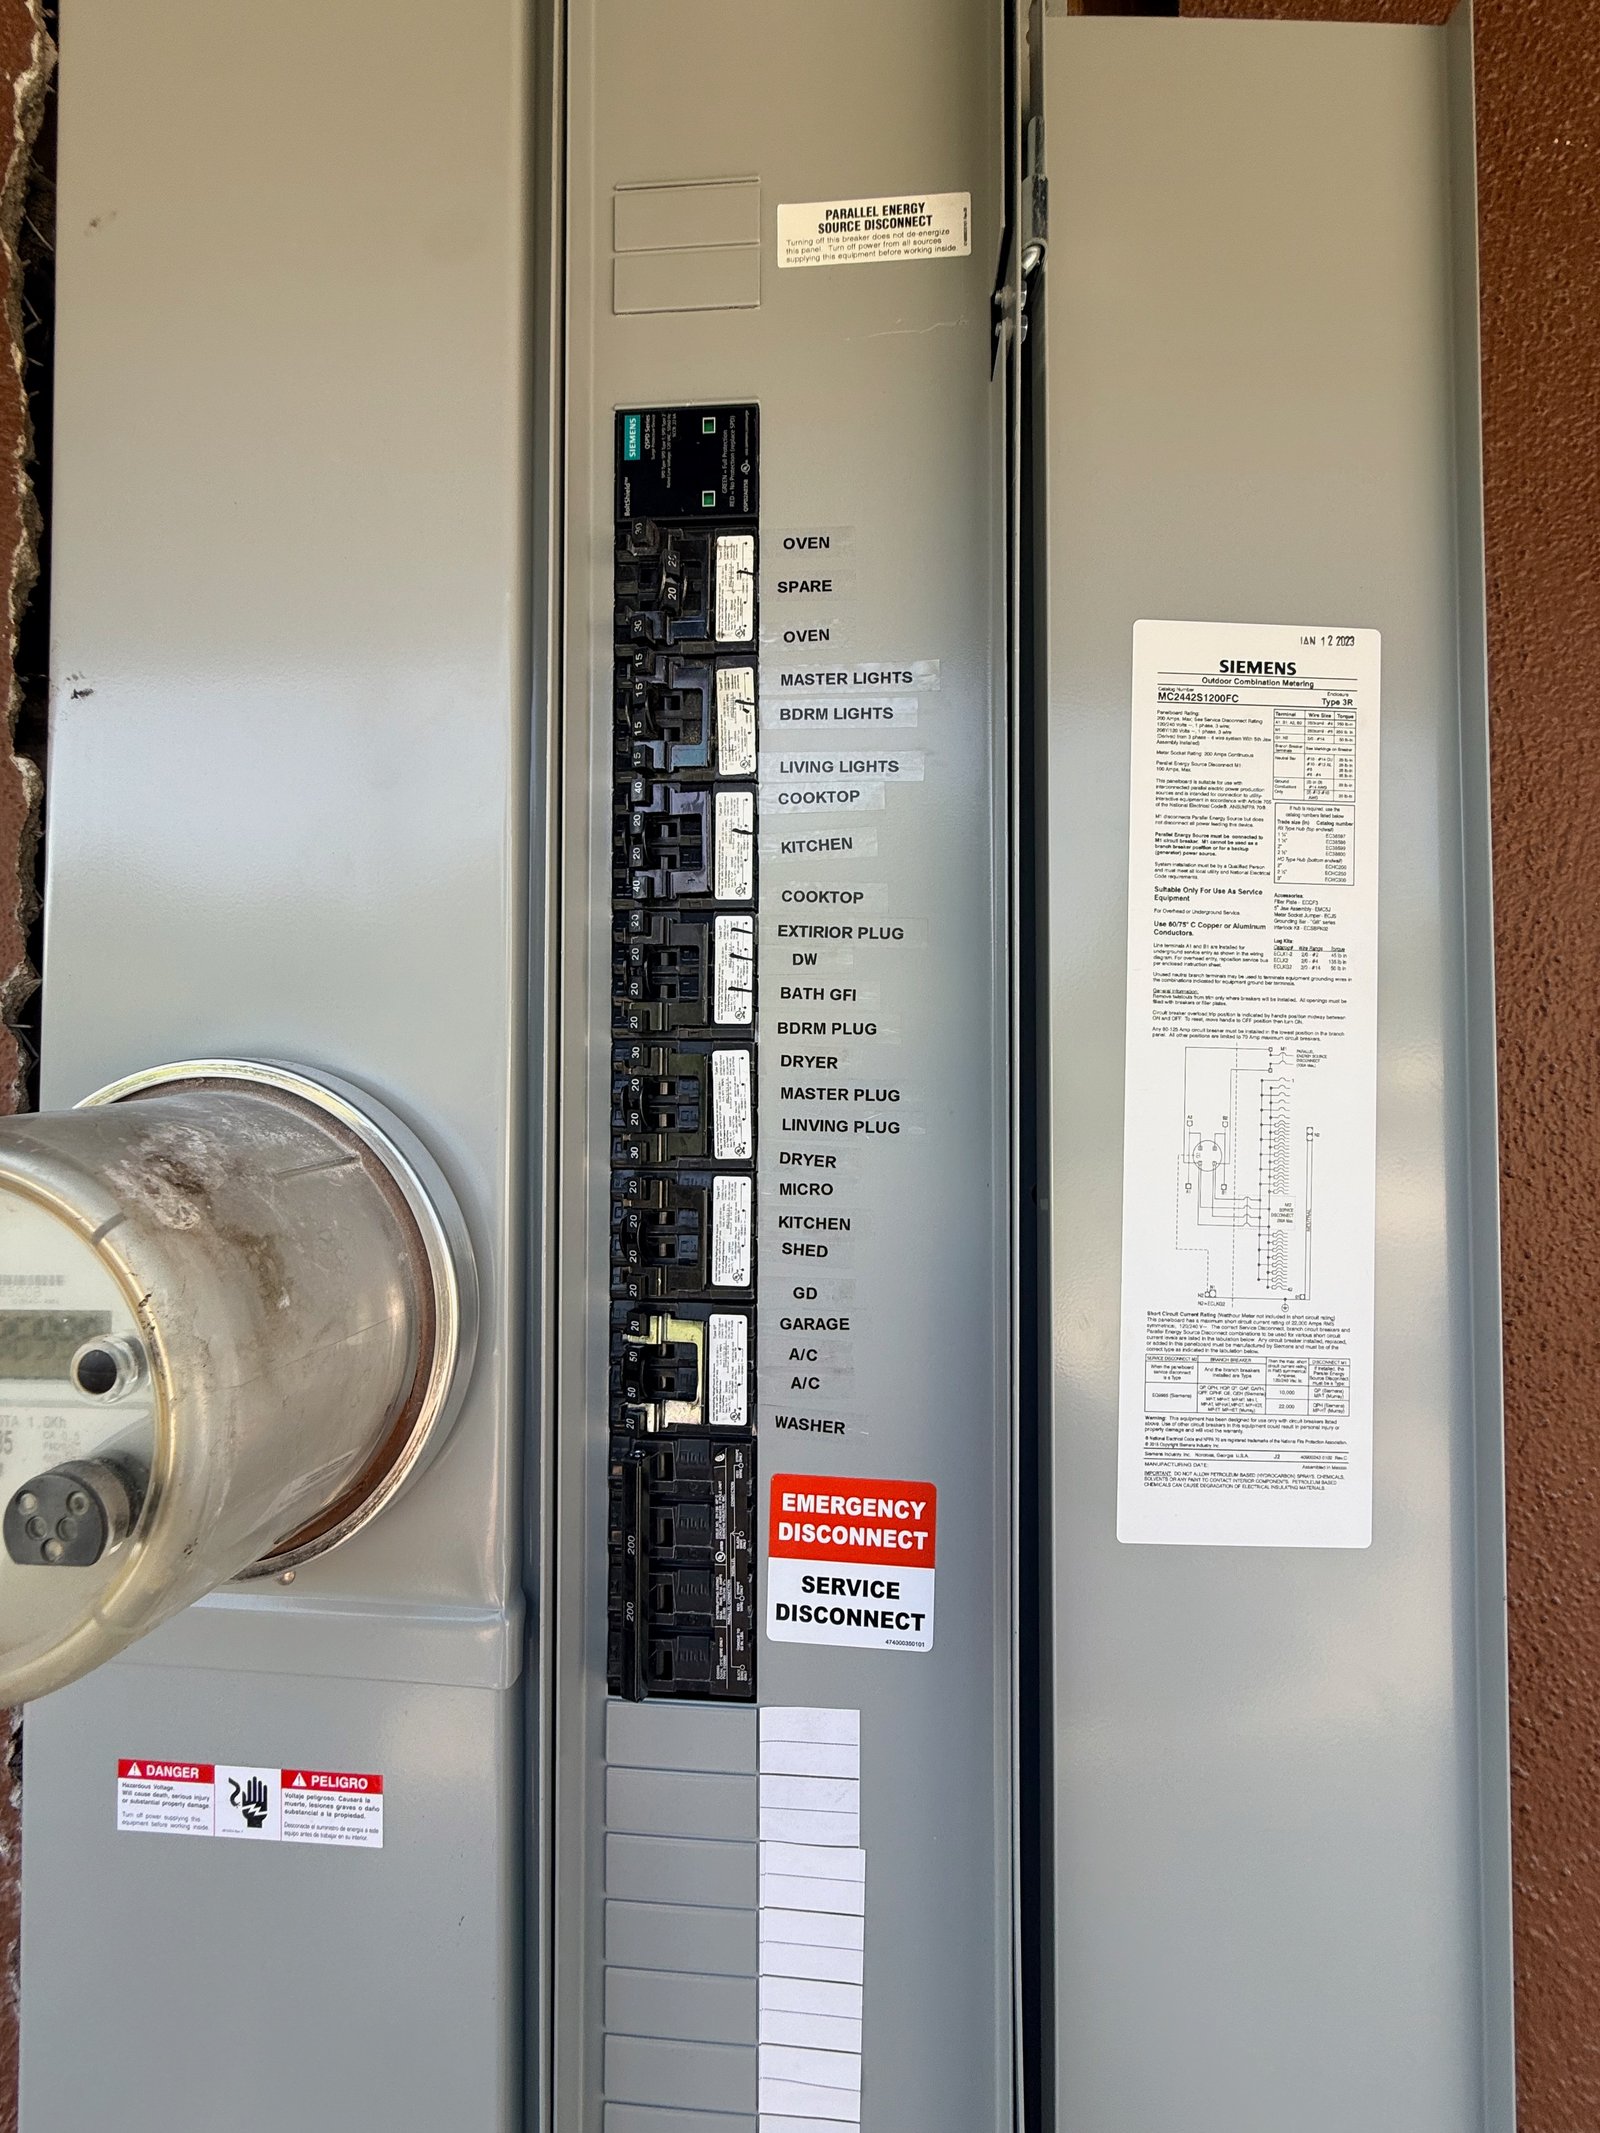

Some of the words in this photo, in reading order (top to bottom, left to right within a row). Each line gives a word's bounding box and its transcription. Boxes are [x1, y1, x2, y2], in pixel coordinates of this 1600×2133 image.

[826, 206, 879, 220] PARALLEL
[882, 202, 925, 216] ENERGY
[818, 220, 861, 234] SOURCE
[865, 215, 933, 231] DISCONNECT
[842, 234, 870, 242] breaker
[907, 229, 950, 238] de-energize
[786, 247, 799, 255] this
[829, 244, 844, 252] Turn
[848, 243, 856, 251] off
[858, 242, 881, 251] power
[787, 254, 820, 264] supplying
[838, 251, 876, 261] equipment
[904, 246, 933, 255] working
[634, 522, 643, 535] 30
[783, 536, 830, 550] OVEN
[668, 587, 677, 600] 20
[777, 580, 832, 593] SPARE
[634, 620, 642, 632] 30
[783, 628, 830, 643] OVEN
[1336, 636, 1355, 646] 2023
[635, 653, 643, 668] 15
[1219, 660, 1296, 676] SIEMENS
[781, 672, 848, 686] MASTER
[853, 671, 913, 684] LIGHTS
[1202, 677, 1232, 685] Outdoor
[1234, 678, 1280, 687] Combination
[1282, 680, 1314, 689] Metering
[635, 682, 643, 697] 15
[1158, 693, 1239, 703] MC2442S1200FC
[1322, 698, 1340, 707] Type
[780, 708, 828, 720] BDRM
[834, 707, 894, 720] LIGHTS
[634, 721, 642, 736] 15
[633, 752, 641, 766] 15
[780, 760, 834, 774] LIVING
[840, 760, 900, 773] LIGHTS
[634, 782, 642, 794] 40
[778, 790, 860, 805] COOKTOP
[633, 814, 641, 827] 20
[781, 837, 852, 854] KITCHEN
[632, 847, 640, 860] 20
[632, 880, 640, 893] 40
[1183, 887, 1198, 895] Only
[782, 890, 864, 904] COOKTOP
[631, 914, 640, 927] 20
[778, 924, 853, 939] EXTIRIOR
[858, 926, 904, 940] PLUG
[631, 948, 640, 961] 20
[792, 953, 818, 966] DW
[630, 982, 638, 996] 20
[780, 986, 824, 1000] BATH
[830, 988, 856, 1002] GFI
[630, 1016, 638, 1029] 20
[777, 1022, 826, 1035] BDRM
[832, 1022, 877, 1035] PLUG
[631, 1046, 640, 1058] 30
[780, 1054, 838, 1070] DRYER
[631, 1078, 640, 1092] 20
[781, 1087, 849, 1101] MASTER
[854, 1088, 900, 1102] PLUG
[630, 1112, 639, 1126] 20
[782, 1118, 848, 1132] LINVING
[854, 1120, 900, 1134] PLUG
[630, 1146, 639, 1159] 30
[780, 1152, 836, 1168] DRYER
[629, 1180, 637, 1194] 20
[780, 1183, 834, 1196] MICRO
[630, 1214, 638, 1228] 20
[778, 1216, 850, 1231] KITCHEN
[629, 1250, 637, 1263] 20
[782, 1242, 828, 1258] SHED
[629, 1284, 637, 1297] 20
[793, 1286, 818, 1300] GD
[630, 1320, 640, 1332] 20
[780, 1318, 850, 1330] GARAGE
[629, 1351, 638, 1362] 50
[788, 1348, 818, 1362] A/C
[790, 1376, 820, 1390] A/C
[627, 1386, 636, 1398] 50
[626, 1418, 635, 1430] 20
[775, 1415, 845, 1435] WASHER
[782, 1493, 926, 1520] EMERGENCY
[778, 1522, 928, 1550] DISCONNECT
[627, 1535, 636, 1555] 200
[801, 1575, 900, 1600] SERVICE
[626, 1602, 634, 1622] 200
[776, 1603, 926, 1631] DISCONNECT
[146, 1764, 199, 1779] DANGER
[311, 1775, 368, 1790] PELIGRO
